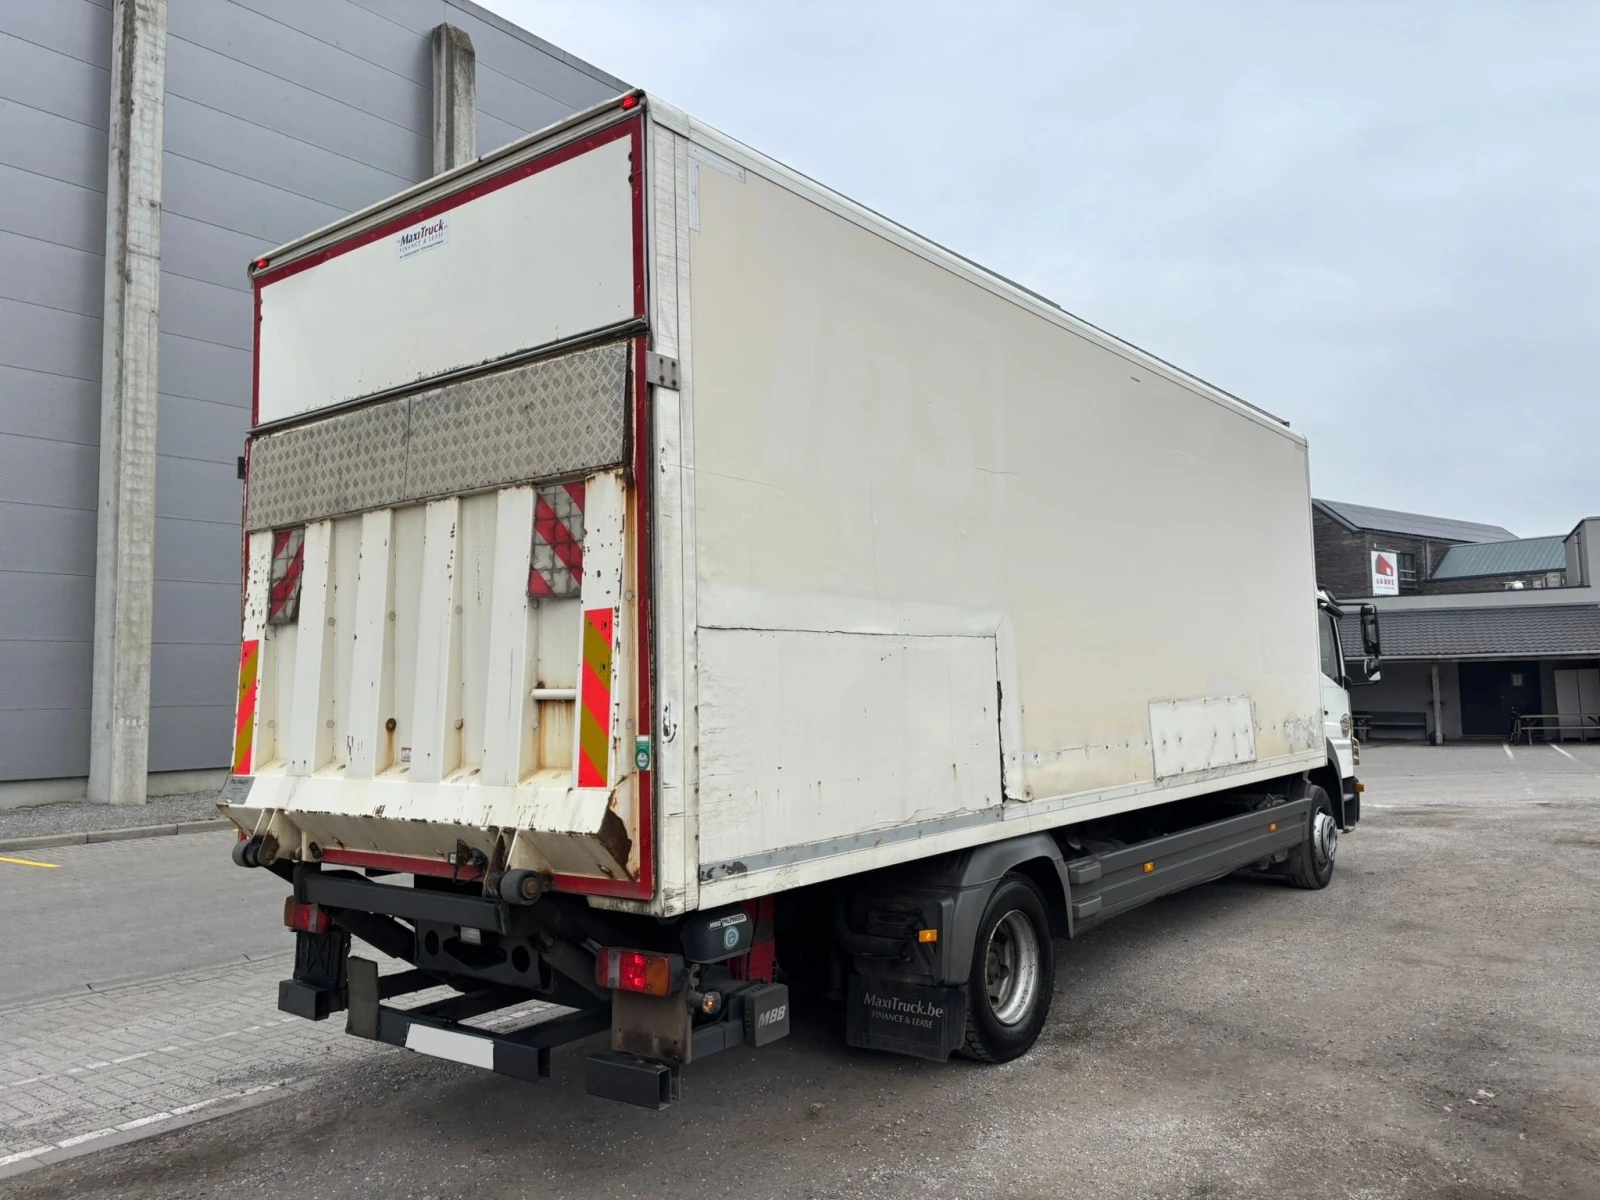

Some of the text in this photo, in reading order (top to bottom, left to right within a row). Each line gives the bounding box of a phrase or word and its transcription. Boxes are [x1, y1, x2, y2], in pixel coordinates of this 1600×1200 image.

[400, 219, 444, 247] MaxiTruck
[757, 1005, 786, 1028] MBB
[863, 992, 944, 1018] MaxiTruck.be
[871, 1010, 934, 1029] FINANCE & LEASE
